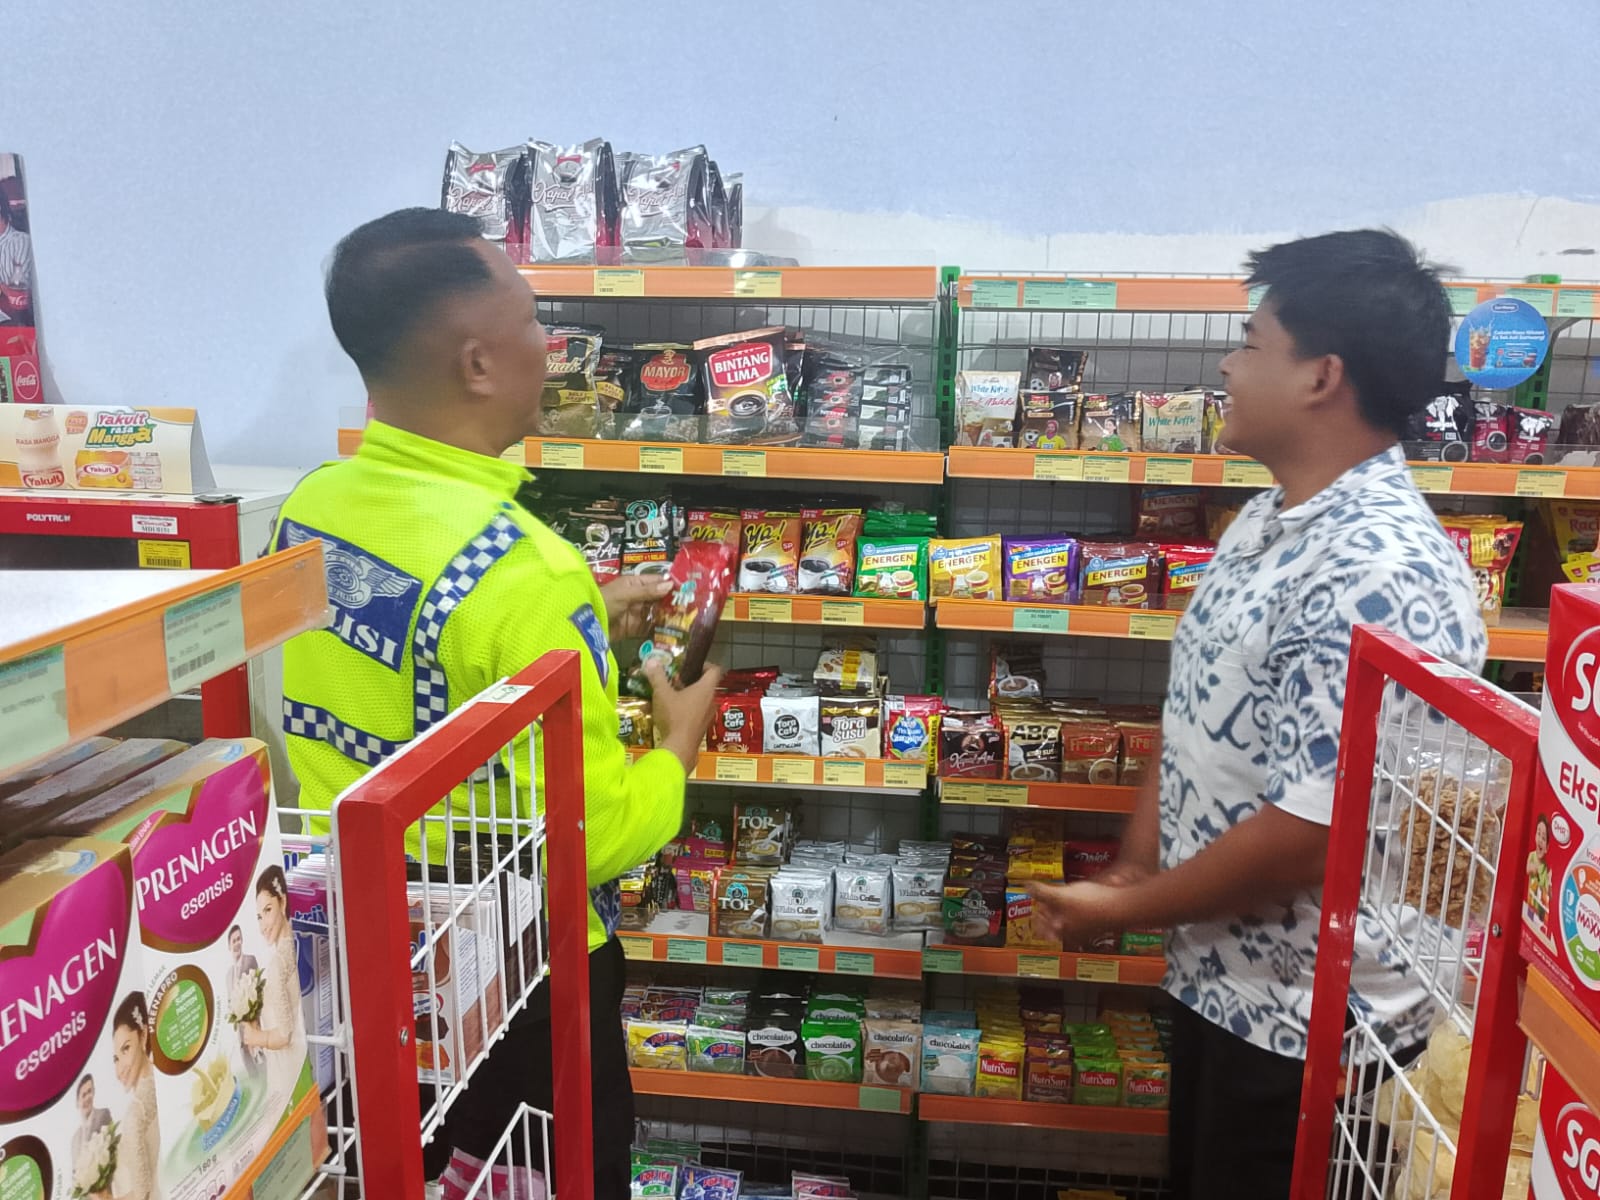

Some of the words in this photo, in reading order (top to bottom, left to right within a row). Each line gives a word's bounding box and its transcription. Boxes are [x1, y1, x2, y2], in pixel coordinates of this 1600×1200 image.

[714, 352, 769, 374] BINTANG
[726, 367, 760, 384] LIMA
[98, 412, 147, 425] Yakult
[1148, 416, 1171, 427] White
[88, 427, 153, 446] Mangga
[27, 474, 61, 487] Yakult
[865, 554, 914, 566] ENERGEN
[938, 554, 987, 569] ENERGEN
[1016, 555, 1066, 569] ENERGEN
[1092, 567, 1143, 581] ENERGEN
[1571, 652, 1600, 717] S
[619, 718, 632, 727] ora
[723, 711, 744, 720] Tora
[724, 719, 745, 728] Cafe
[776, 718, 798, 728] Tora
[831, 716, 867, 731] Tora
[778, 726, 798, 737] Cafe
[833, 729, 866, 743] Susu
[1010, 725, 1058, 740] ABC
[1559, 761, 1600, 826] Eks
[738, 816, 773, 829] TOP
[135, 810, 257, 911] PRENAGEN
[181, 872, 234, 920] esensis
[860, 894, 881, 902] Coffee
[920, 889, 942, 897] Coffee
[718, 897, 754, 911] TOP
[797, 906, 818, 915] Coffee
[0, 928, 117, 1049] ENAGEN
[15, 1011, 87, 1081] esensis
[981, 1060, 1017, 1077] NutriSari
[1031, 1073, 1067, 1087] NutriSari
[1079, 1072, 1116, 1086] NutriSari
[1129, 1080, 1165, 1095] NutriSari
[1562, 1119, 1600, 1195] SG
